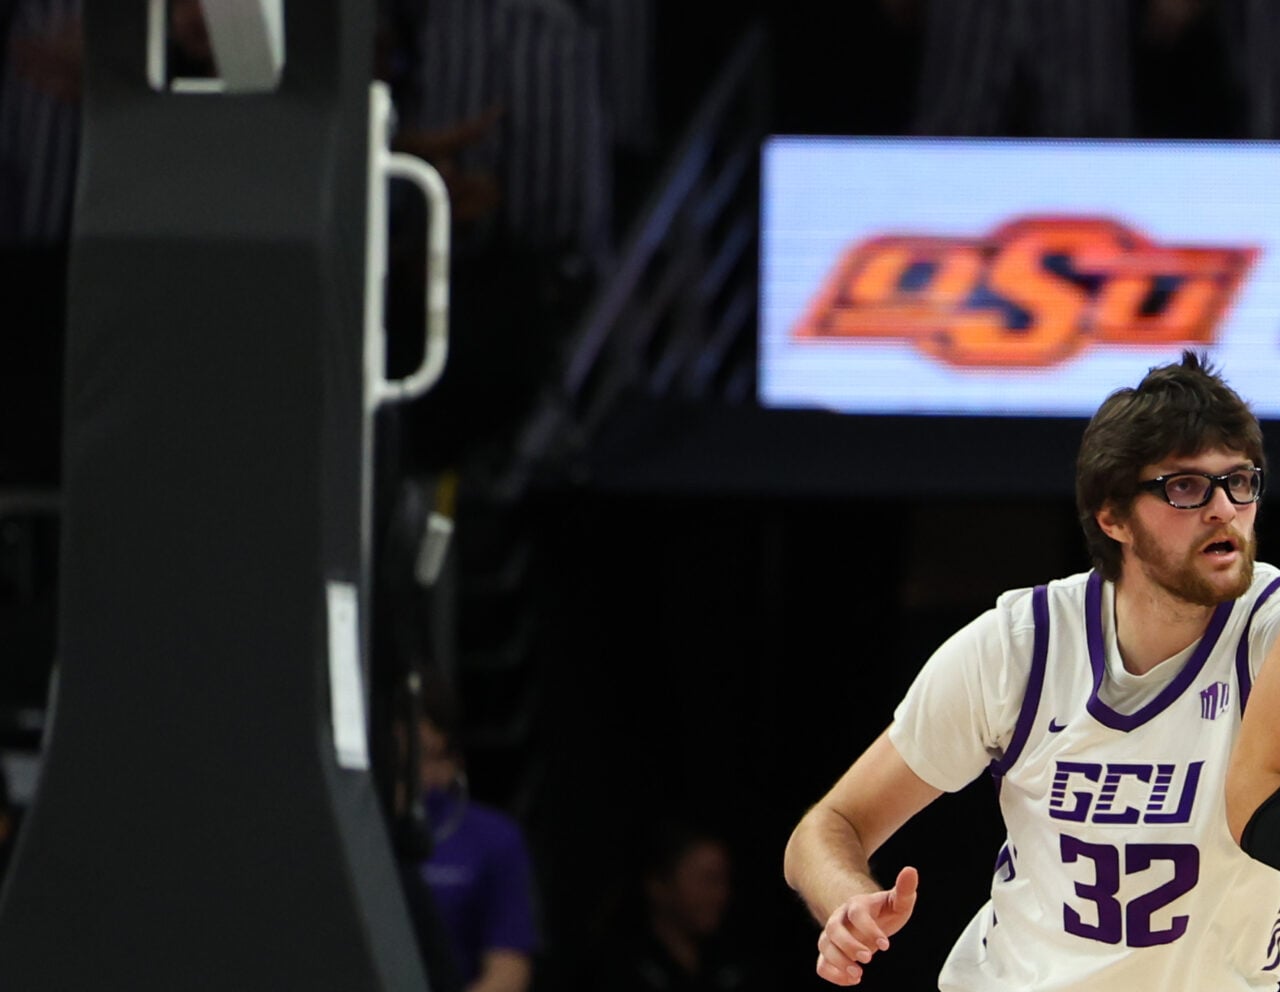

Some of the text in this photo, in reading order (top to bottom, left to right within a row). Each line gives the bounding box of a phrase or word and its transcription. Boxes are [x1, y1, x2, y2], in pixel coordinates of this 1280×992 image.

[796, 215, 1258, 369] OSU
[1049, 760, 1205, 825] GCU
[1060, 833, 1200, 948] 32
